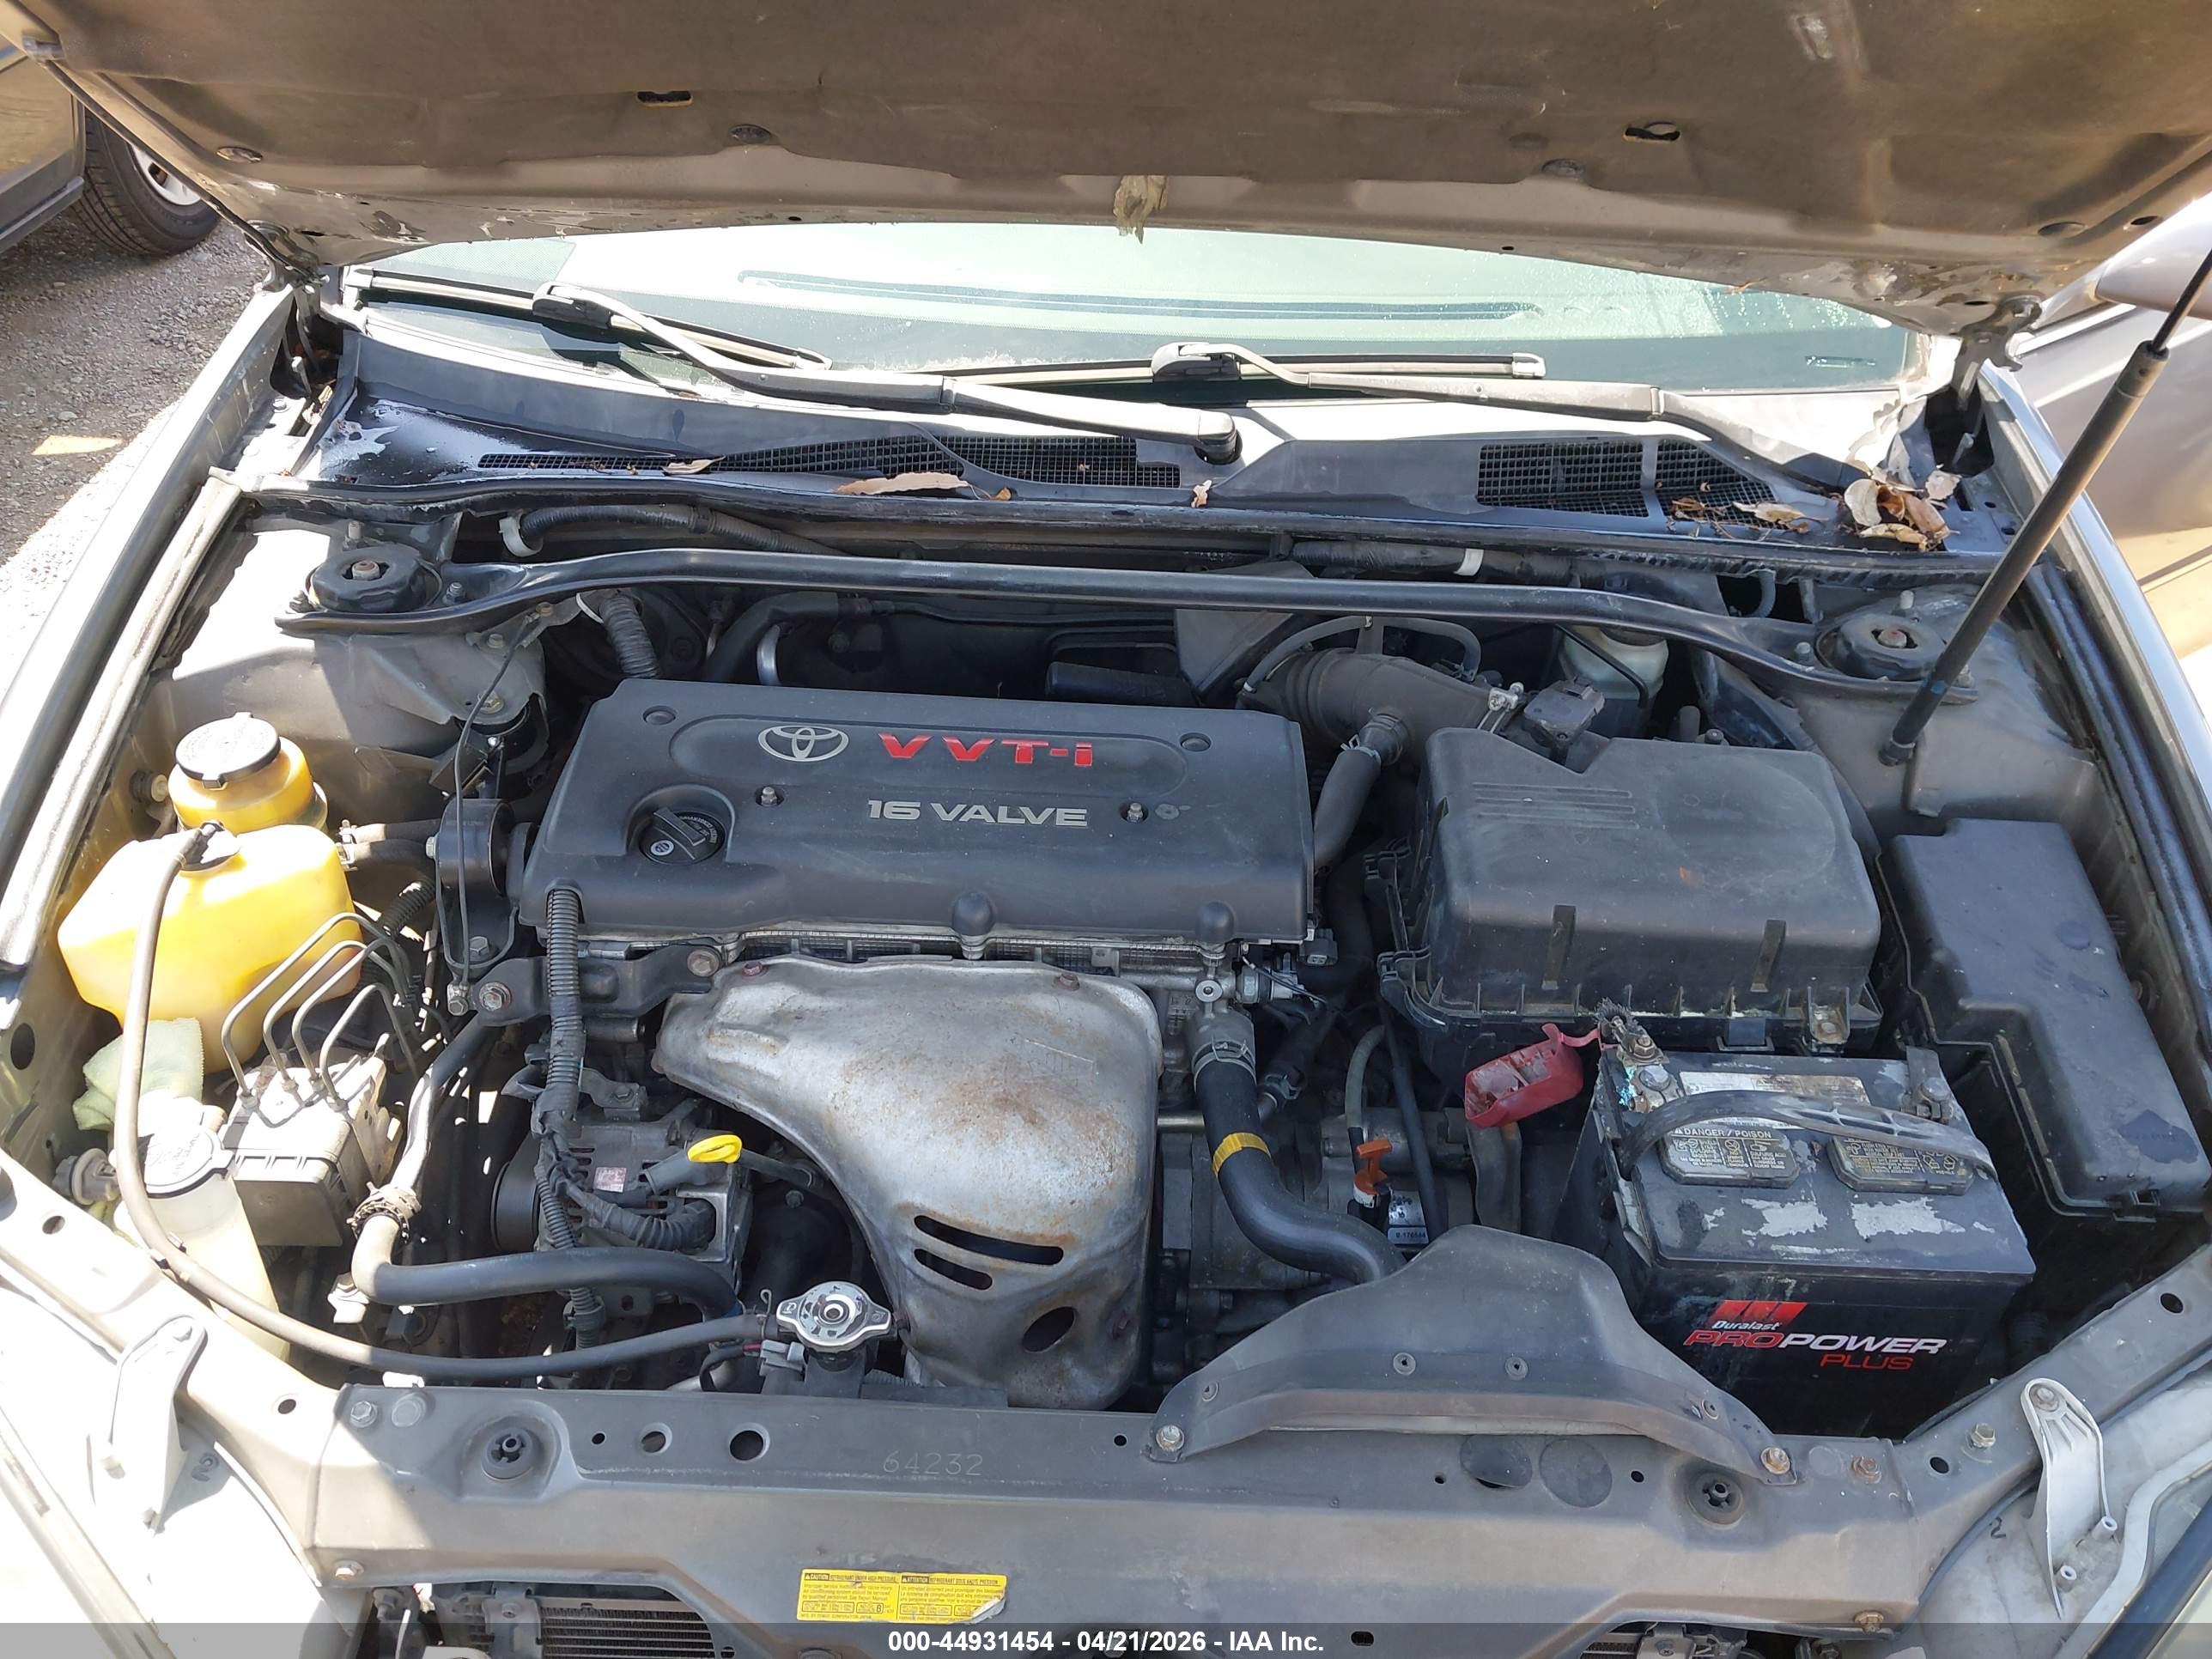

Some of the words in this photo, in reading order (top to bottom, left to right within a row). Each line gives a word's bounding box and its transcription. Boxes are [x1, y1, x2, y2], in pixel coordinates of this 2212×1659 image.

[878, 732, 1093, 767] VVT-i
[867, 799, 921, 821] 16
[930, 803, 1088, 827] VALVE
[1684, 1127, 1725, 1137] DANGER
[1735, 1129, 1772, 1139] POISON
[1711, 1320, 1780, 1331] Duralast
[1820, 1353, 1915, 1370] PLUS
[883, 1450, 983, 1476] 64232
